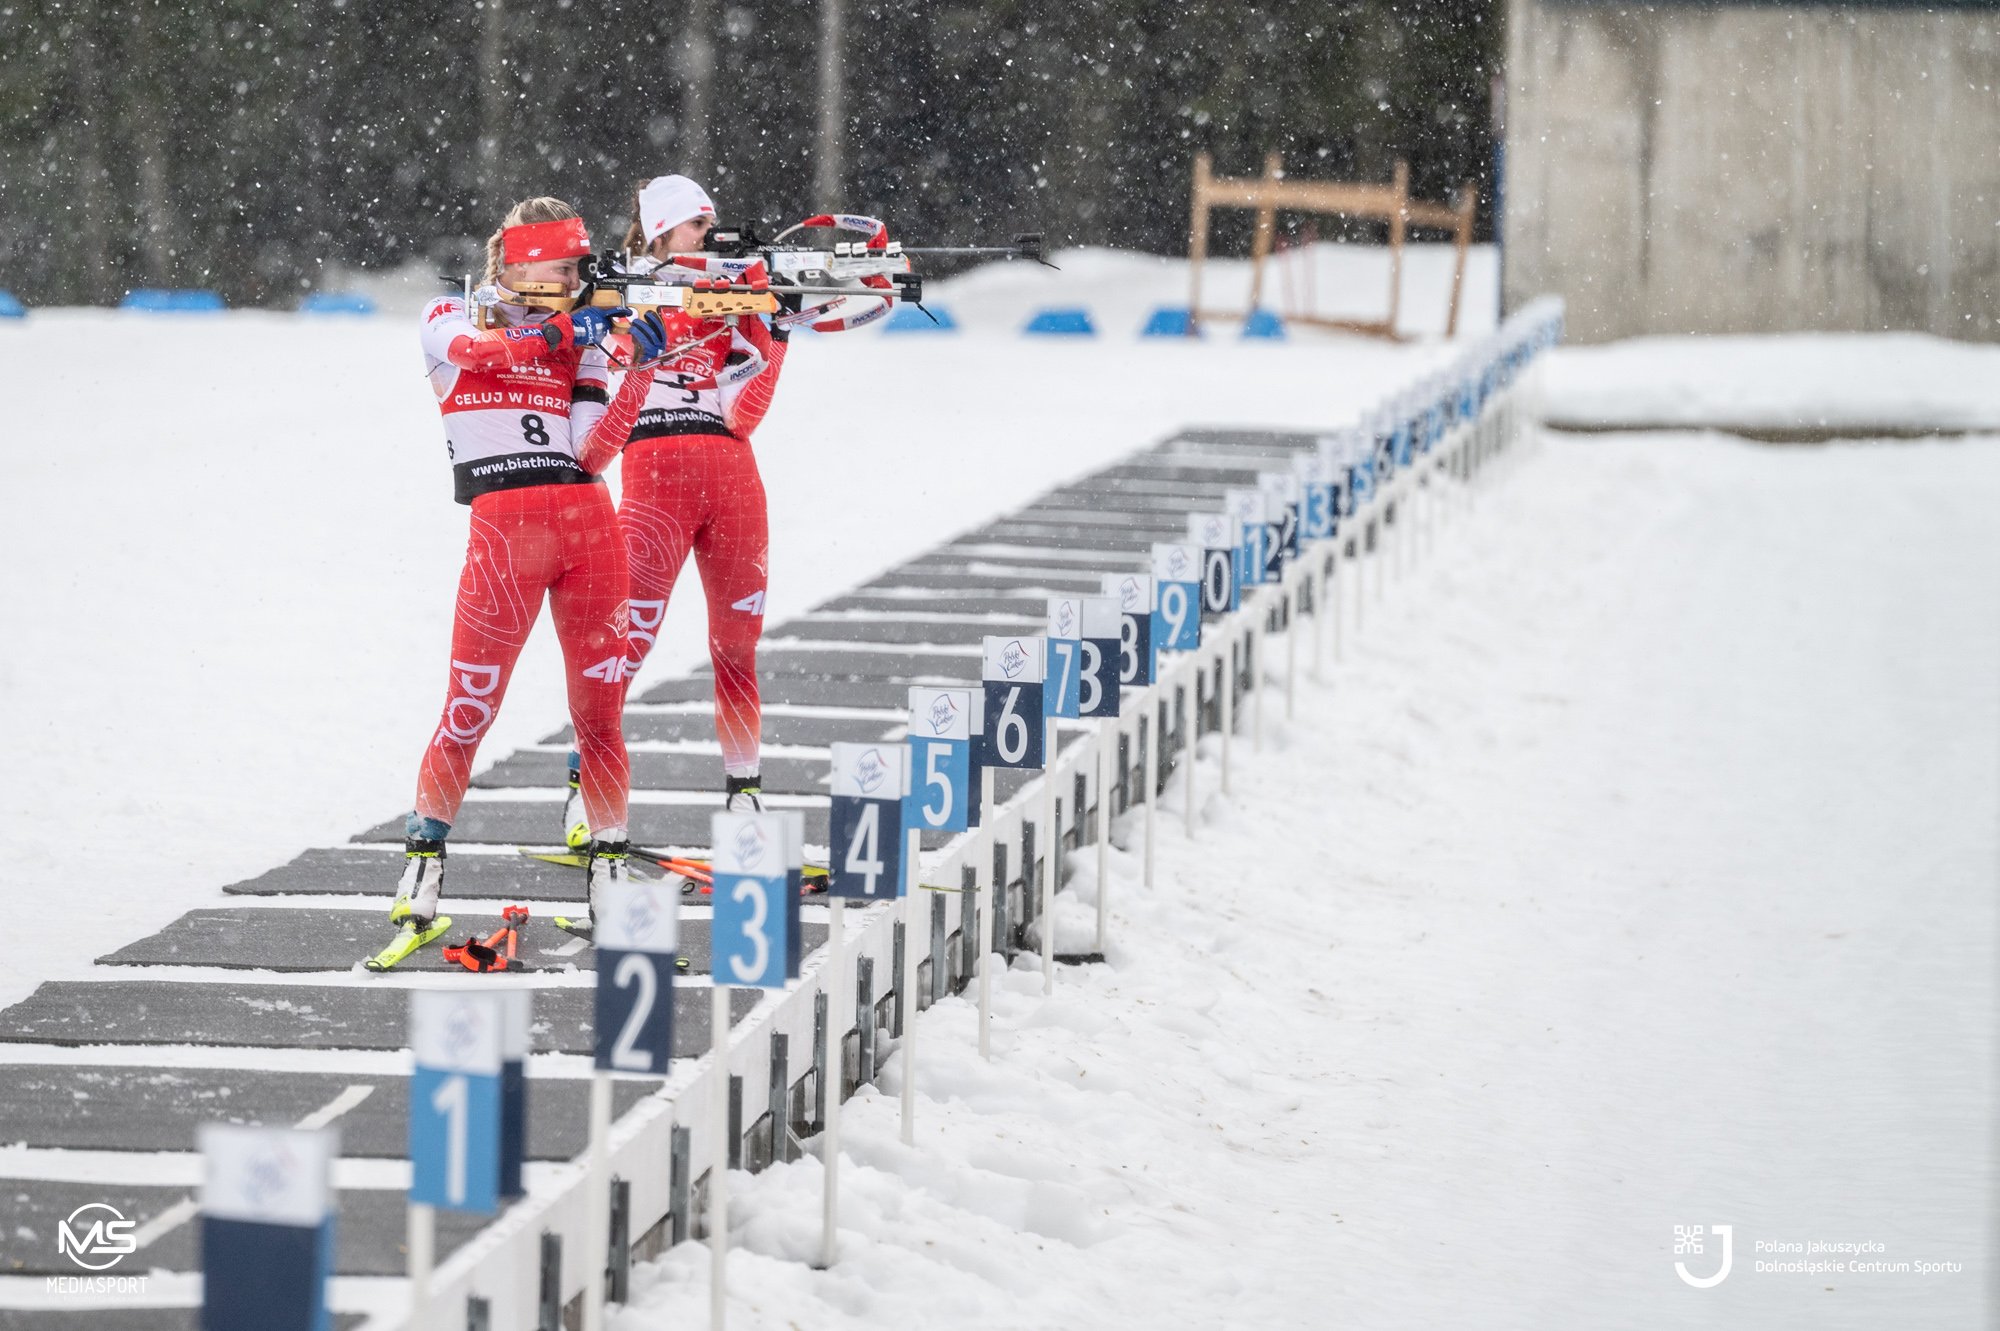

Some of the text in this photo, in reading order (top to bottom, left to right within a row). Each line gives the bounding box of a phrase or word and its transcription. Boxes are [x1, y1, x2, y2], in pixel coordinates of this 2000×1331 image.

[455, 391, 503, 406] CELUJ
[508, 392, 523, 404] W
[520, 414, 550, 446] 8
[1161, 584, 1187, 648] 9
[1055, 643, 1073, 714] 7
[996, 686, 1029, 764] 6
[921, 742, 954, 827] 5
[844, 803, 884, 895] 4
[729, 879, 769, 983] 3
[610, 953, 658, 1072] 2
[431, 1075, 468, 1204] 1
